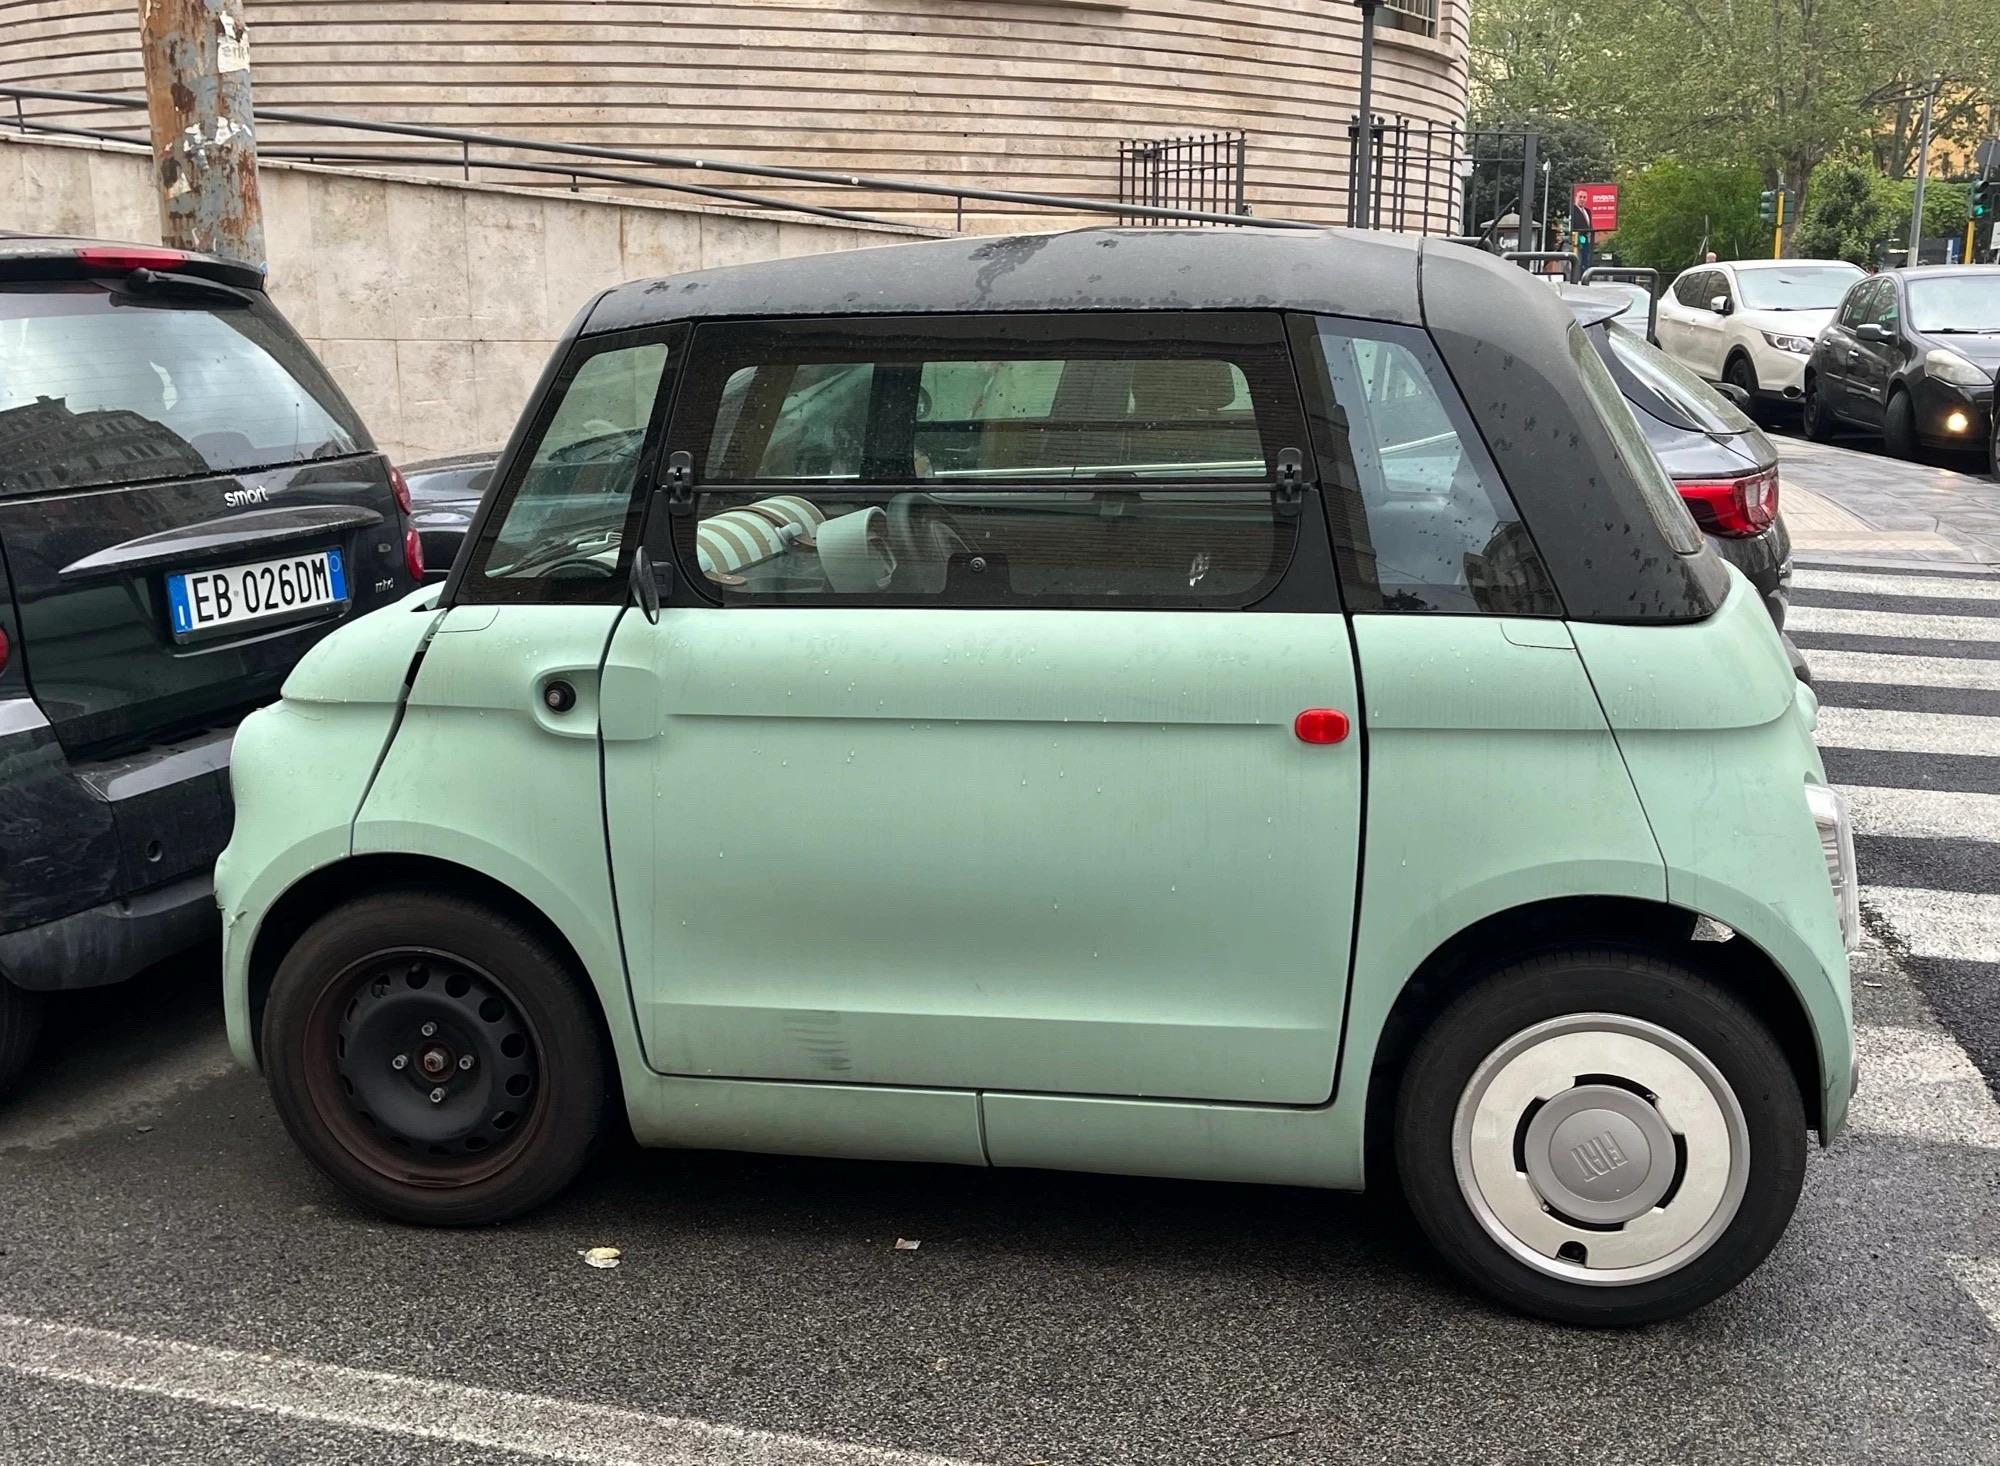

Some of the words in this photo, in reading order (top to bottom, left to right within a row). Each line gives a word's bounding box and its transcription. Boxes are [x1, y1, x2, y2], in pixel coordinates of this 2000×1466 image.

[224, 485, 269, 507] smart
[192, 573, 233, 623] EB
[242, 557, 330, 613] 026DM
[1570, 1130, 1628, 1183] FIAT
